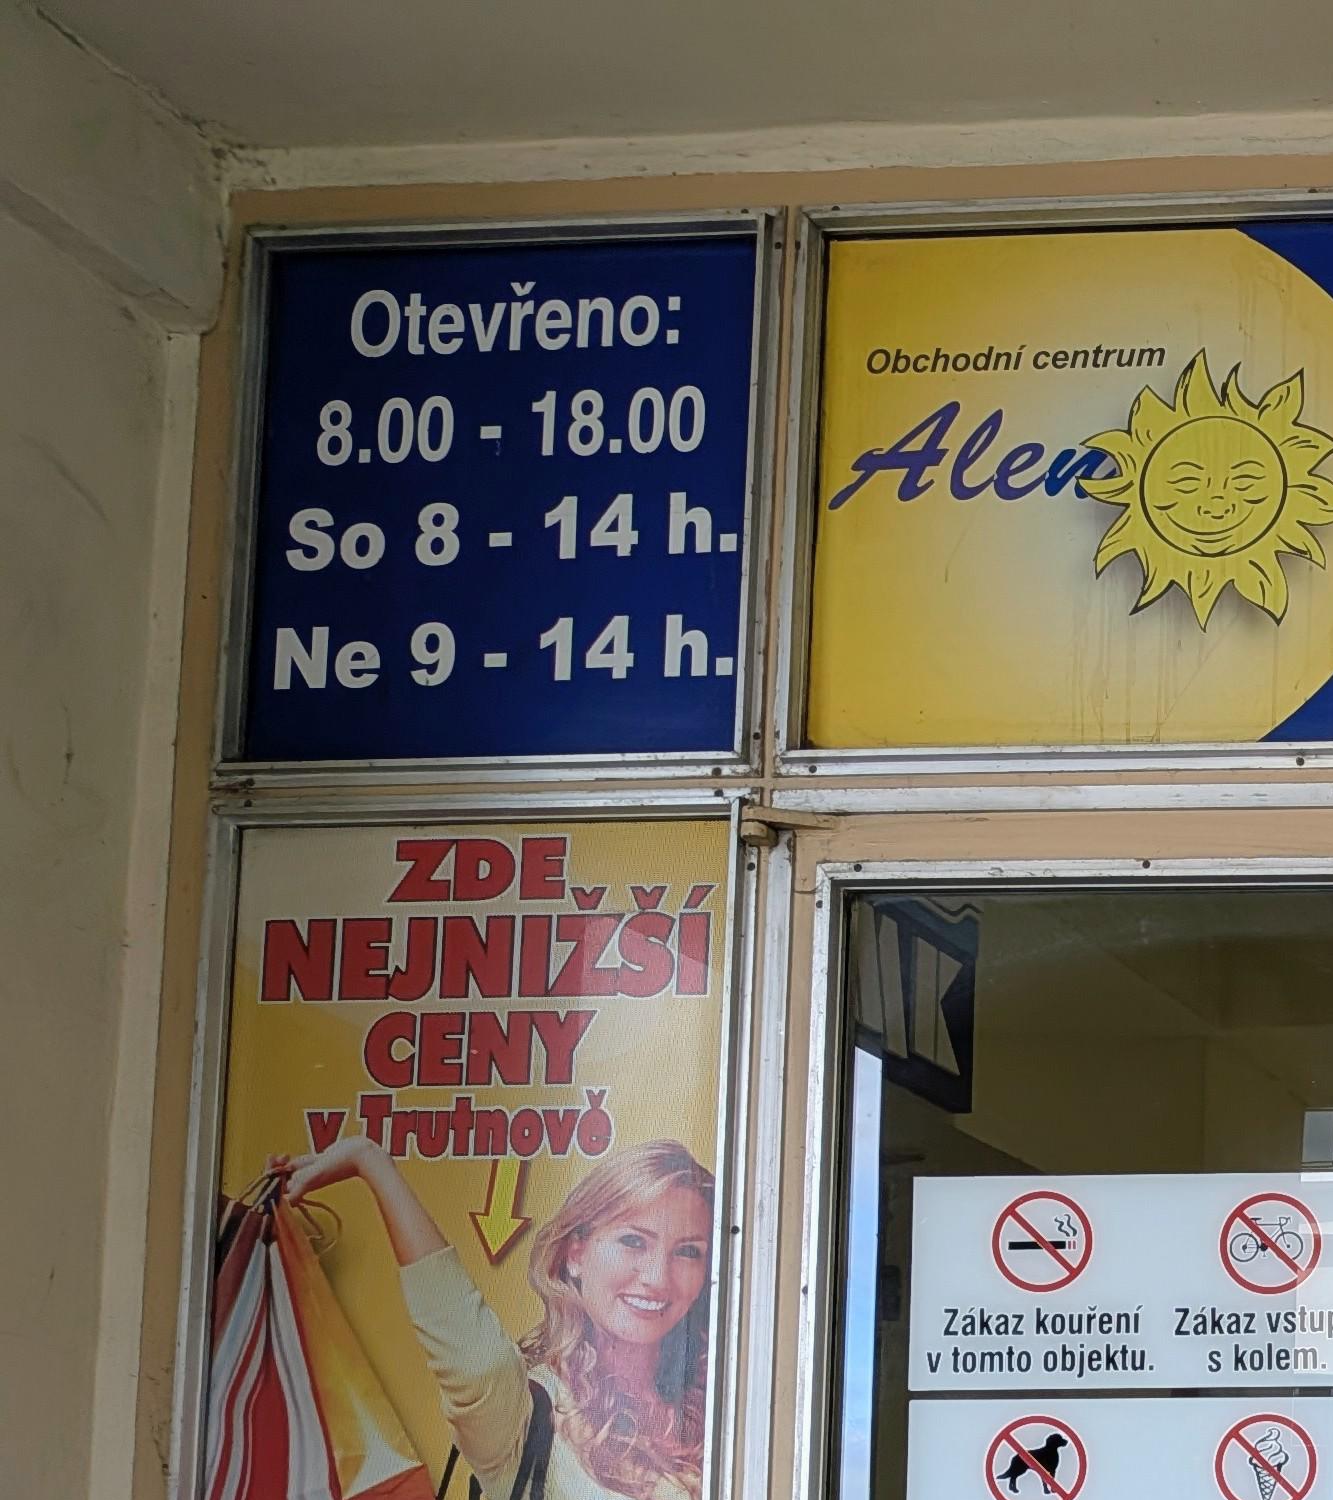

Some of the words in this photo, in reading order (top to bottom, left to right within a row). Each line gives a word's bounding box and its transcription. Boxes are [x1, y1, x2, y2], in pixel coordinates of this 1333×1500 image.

[350, 281, 682, 358] Otevřeno:
[866, 345, 1024, 375] Obchodní
[1032, 345, 1167, 371] centrum
[317, 395, 454, 466] 8.00
[532, 385, 706, 457] 18.00
[285, 508, 386, 572] So
[415, 502, 460, 567] 8
[544, 493, 639, 560] 14
[668, 492, 738, 555] h.
[273, 626, 381, 690] Ne
[410, 622, 455, 687] 9
[539, 615, 634, 681] 14
[664, 614, 734, 678] h.
[385, 834, 570, 904] ZDE
[259, 883, 719, 1004] NEJNIŽŠÍ
[362, 1008, 598, 1089] CENY
[306, 1109, 347, 1155] v
[358, 1087, 614, 1159] Trutnově
[943, 1307, 1025, 1336] Zákaz
[1035, 1305, 1143, 1335] kouření
[1174, 1307, 1256, 1336] Zákaz
[927, 1350, 943, 1373] v
[952, 1346, 1033, 1373] tomto
[1043, 1343, 1155, 1378] objektu.
[1208, 1348, 1222, 1372] s
[1233, 1343, 1328, 1372] kolem.
